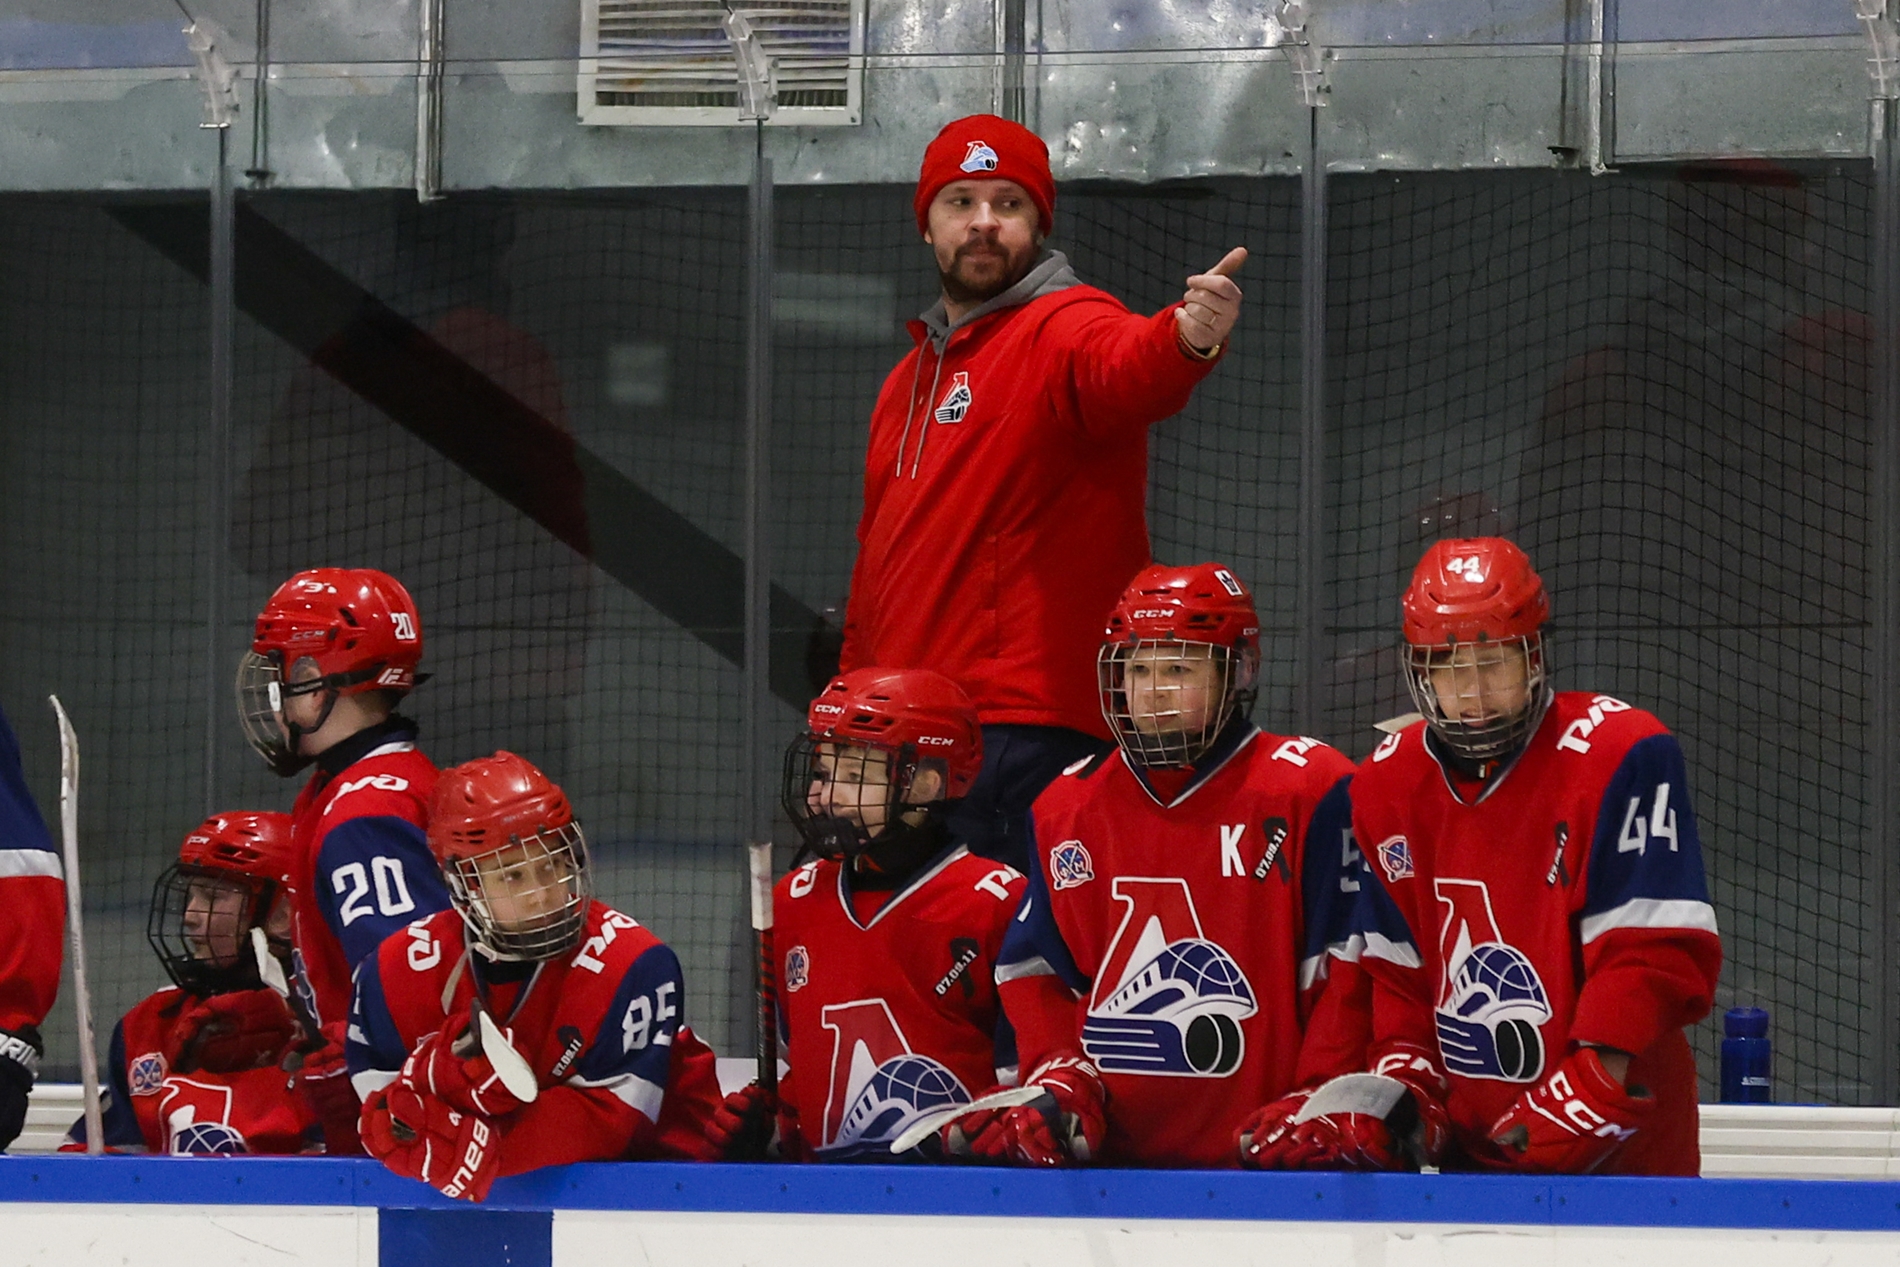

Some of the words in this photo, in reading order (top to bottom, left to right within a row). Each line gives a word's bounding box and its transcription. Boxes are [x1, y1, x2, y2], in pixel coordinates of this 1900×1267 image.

[1446, 556, 1479, 574] 44
[390, 612, 416, 640] 20
[1133, 609, 1175, 619] CCM
[814, 704, 841, 715] CCM
[918, 736, 955, 746] CCM
[1618, 782, 1679, 857] 44
[1220, 824, 1246, 877] K
[1254, 827, 1287, 880] 07.09.11
[332, 855, 415, 927] 20
[935, 949, 978, 996] 07.09.11
[622, 980, 676, 1055] 85
